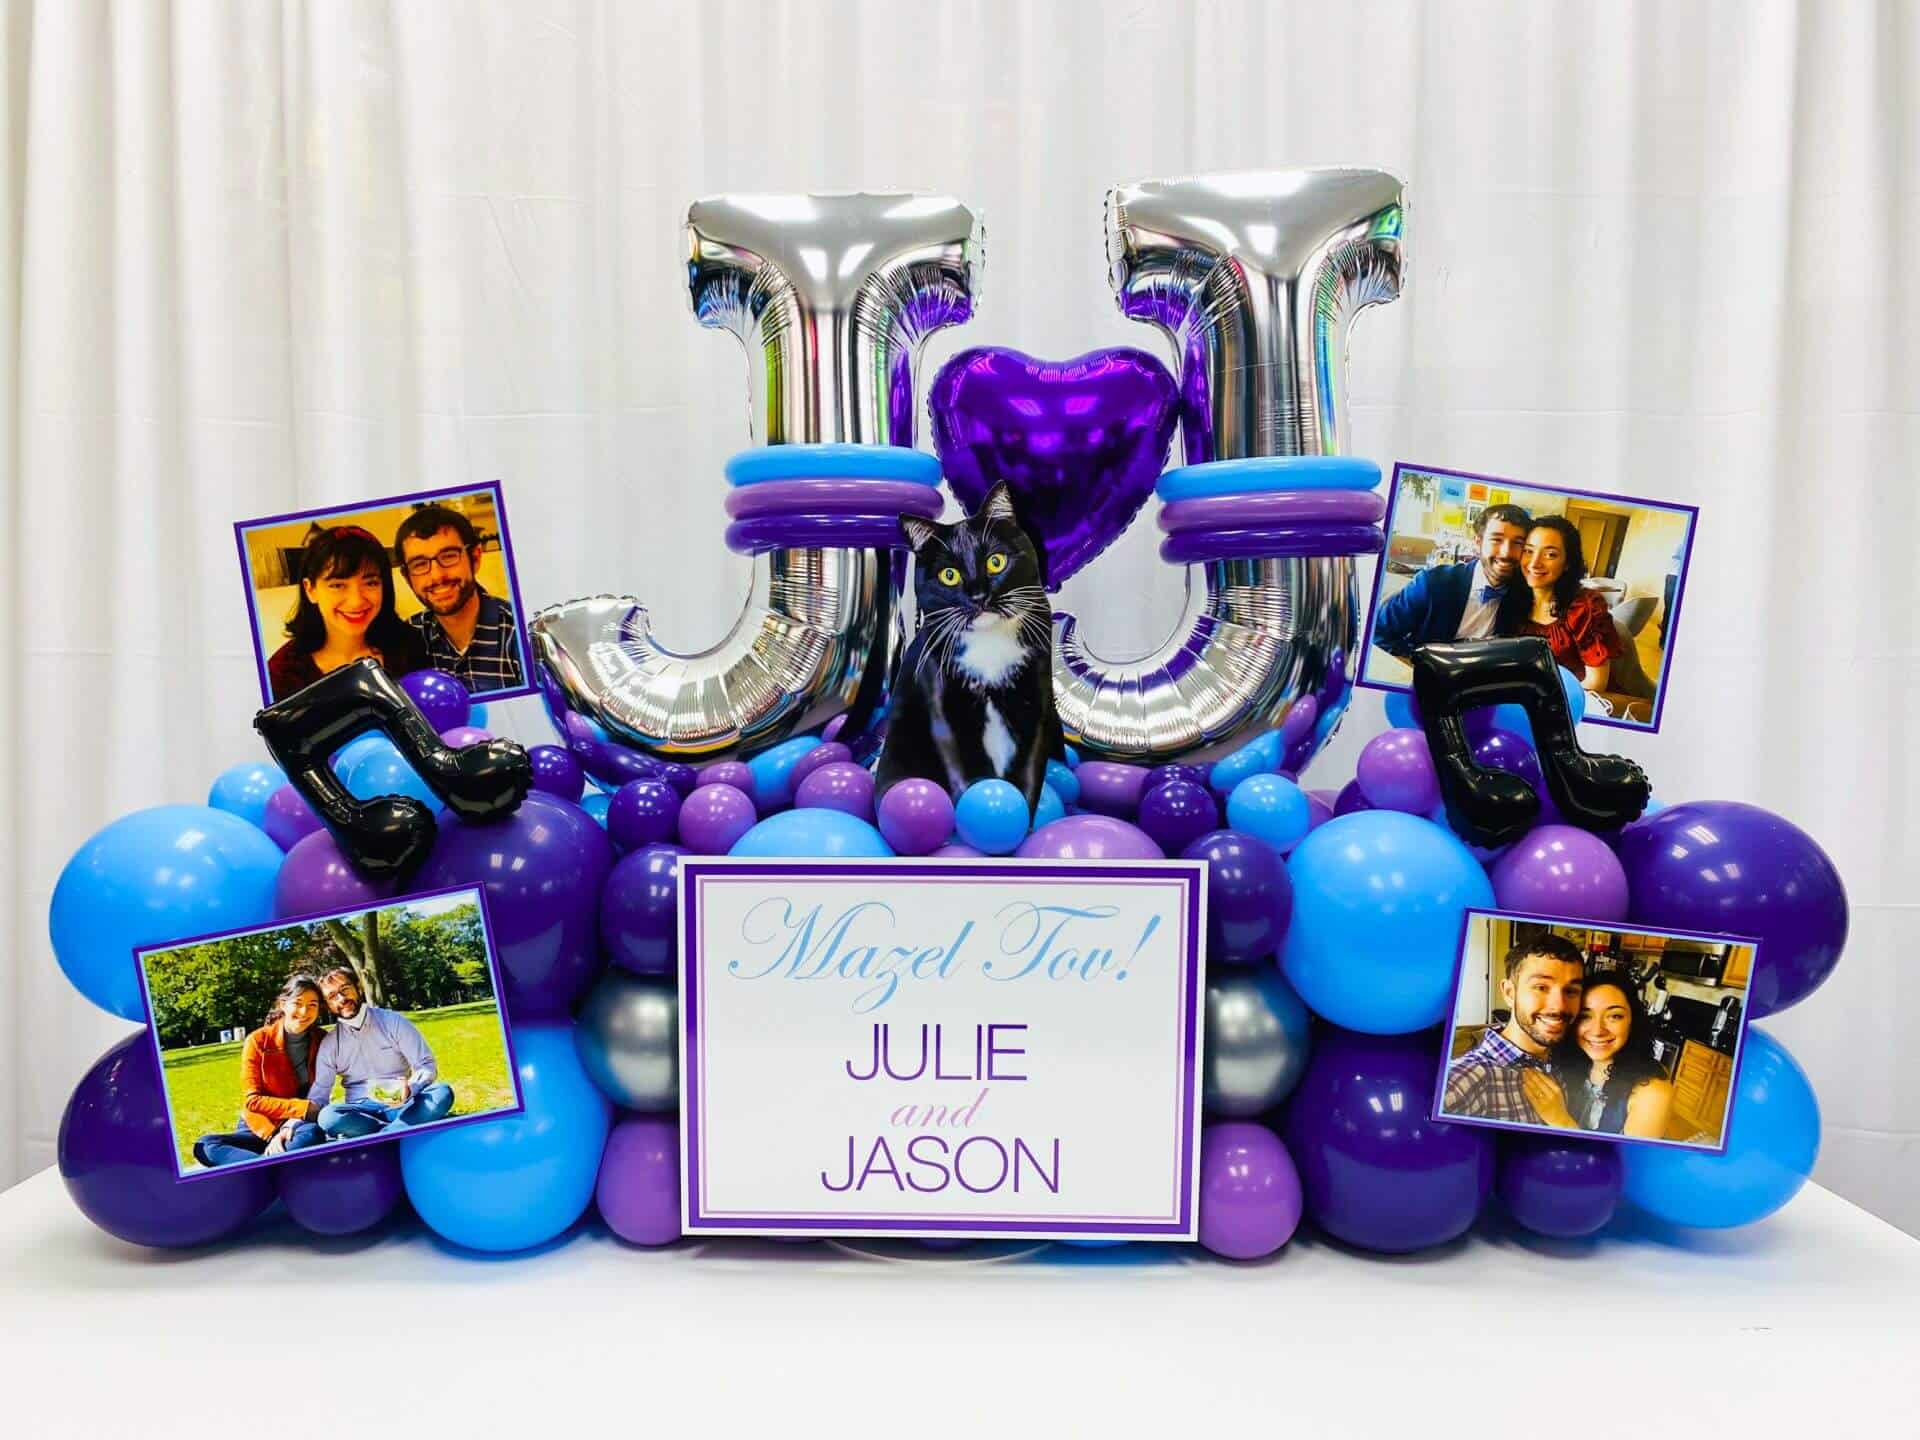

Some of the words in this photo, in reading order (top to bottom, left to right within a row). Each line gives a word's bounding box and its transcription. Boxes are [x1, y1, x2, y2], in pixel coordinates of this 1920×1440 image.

[727, 896, 976, 1015] Mazel
[983, 900, 1161, 983] Tov!
[846, 1023, 1028, 1081] JULIE
[889, 1087, 990, 1129] and
[821, 1135, 1061, 1194] JASON
